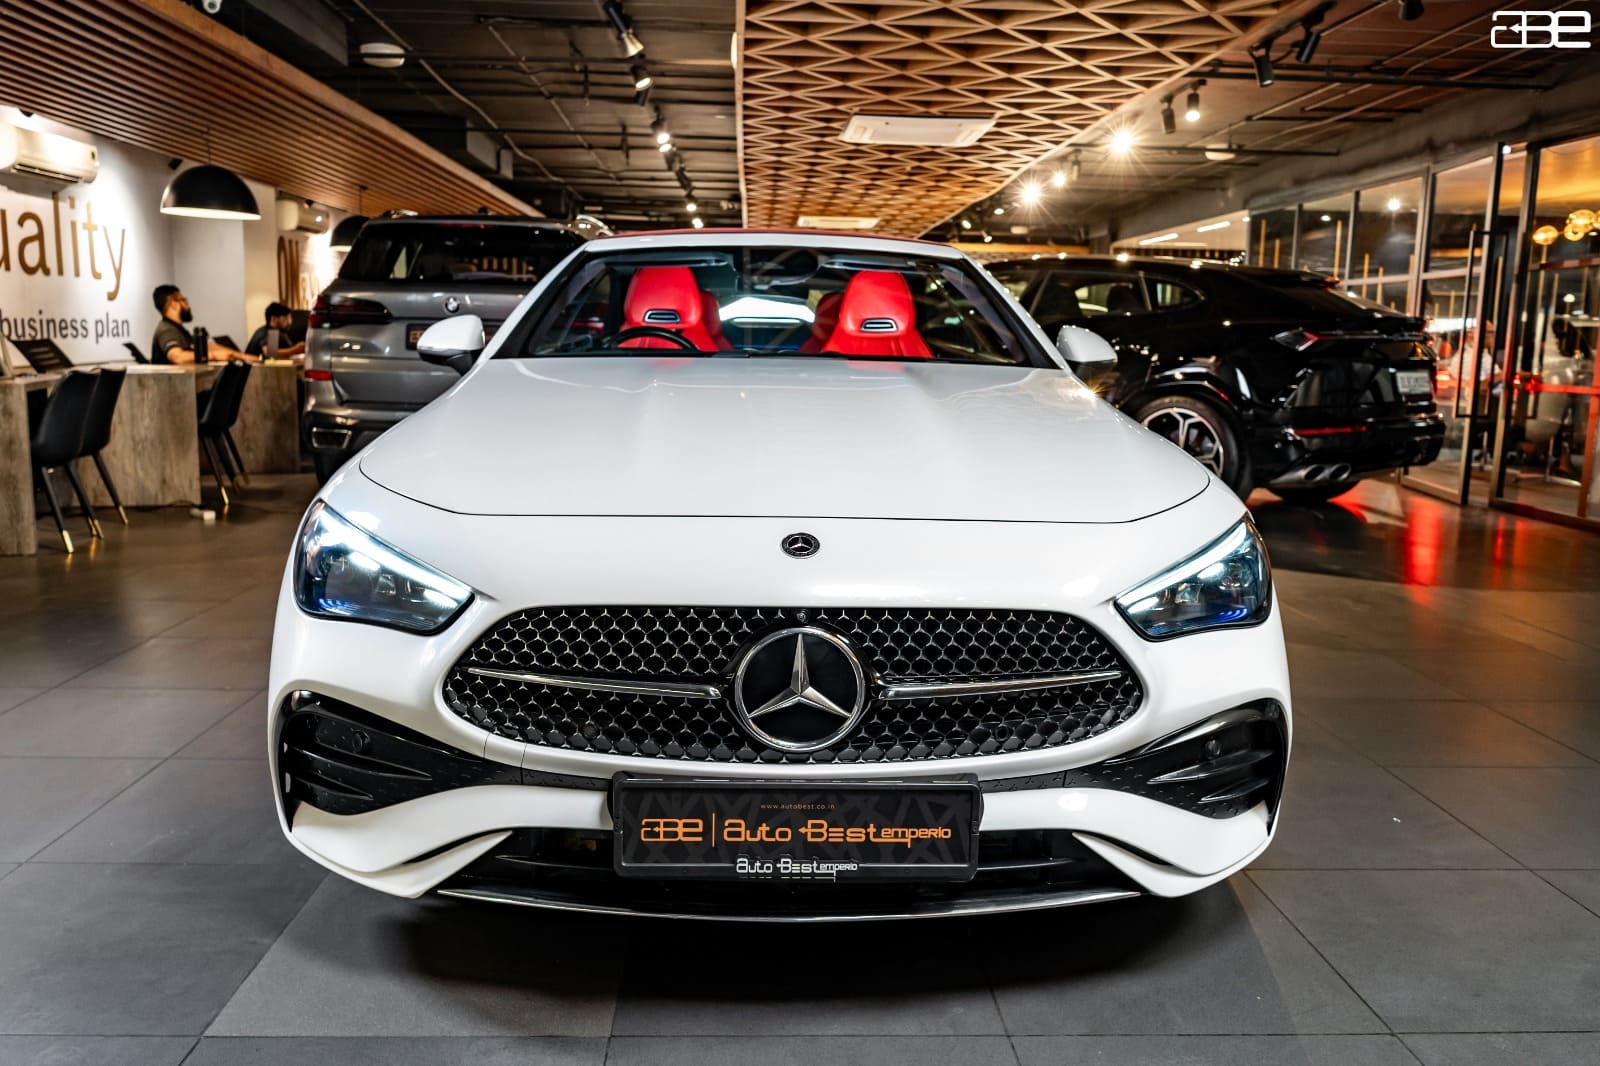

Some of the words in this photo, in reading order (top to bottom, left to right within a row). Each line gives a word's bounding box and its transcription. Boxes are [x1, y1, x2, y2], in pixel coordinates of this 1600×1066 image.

[0, 190, 126, 301] ality
[0, 308, 89, 341] business
[94, 310, 131, 344] plan
